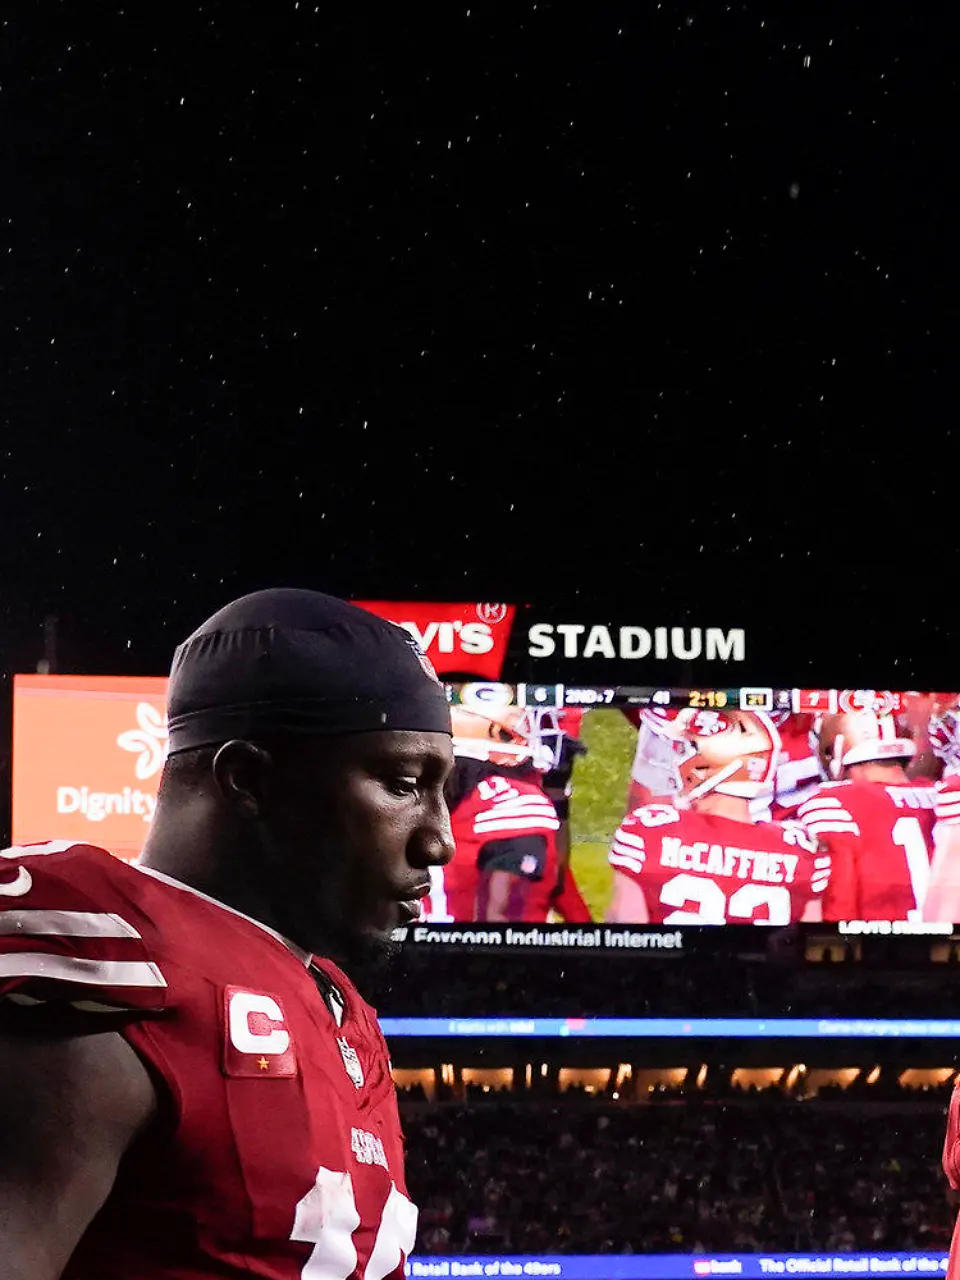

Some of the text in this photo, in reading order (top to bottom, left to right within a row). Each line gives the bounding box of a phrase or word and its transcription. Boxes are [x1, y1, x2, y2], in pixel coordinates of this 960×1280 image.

[400, 620, 746, 661] VI'S STADIUM
[688, 690, 727, 706] 2:19
[57, 786, 156, 822] Dignity
[660, 837, 799, 883] McCAFFREY
[506, 928, 601, 947] Industrial
[604, 929, 683, 948] Internet
[230, 992, 290, 1054] C
[759, 1258, 785, 1273] The
